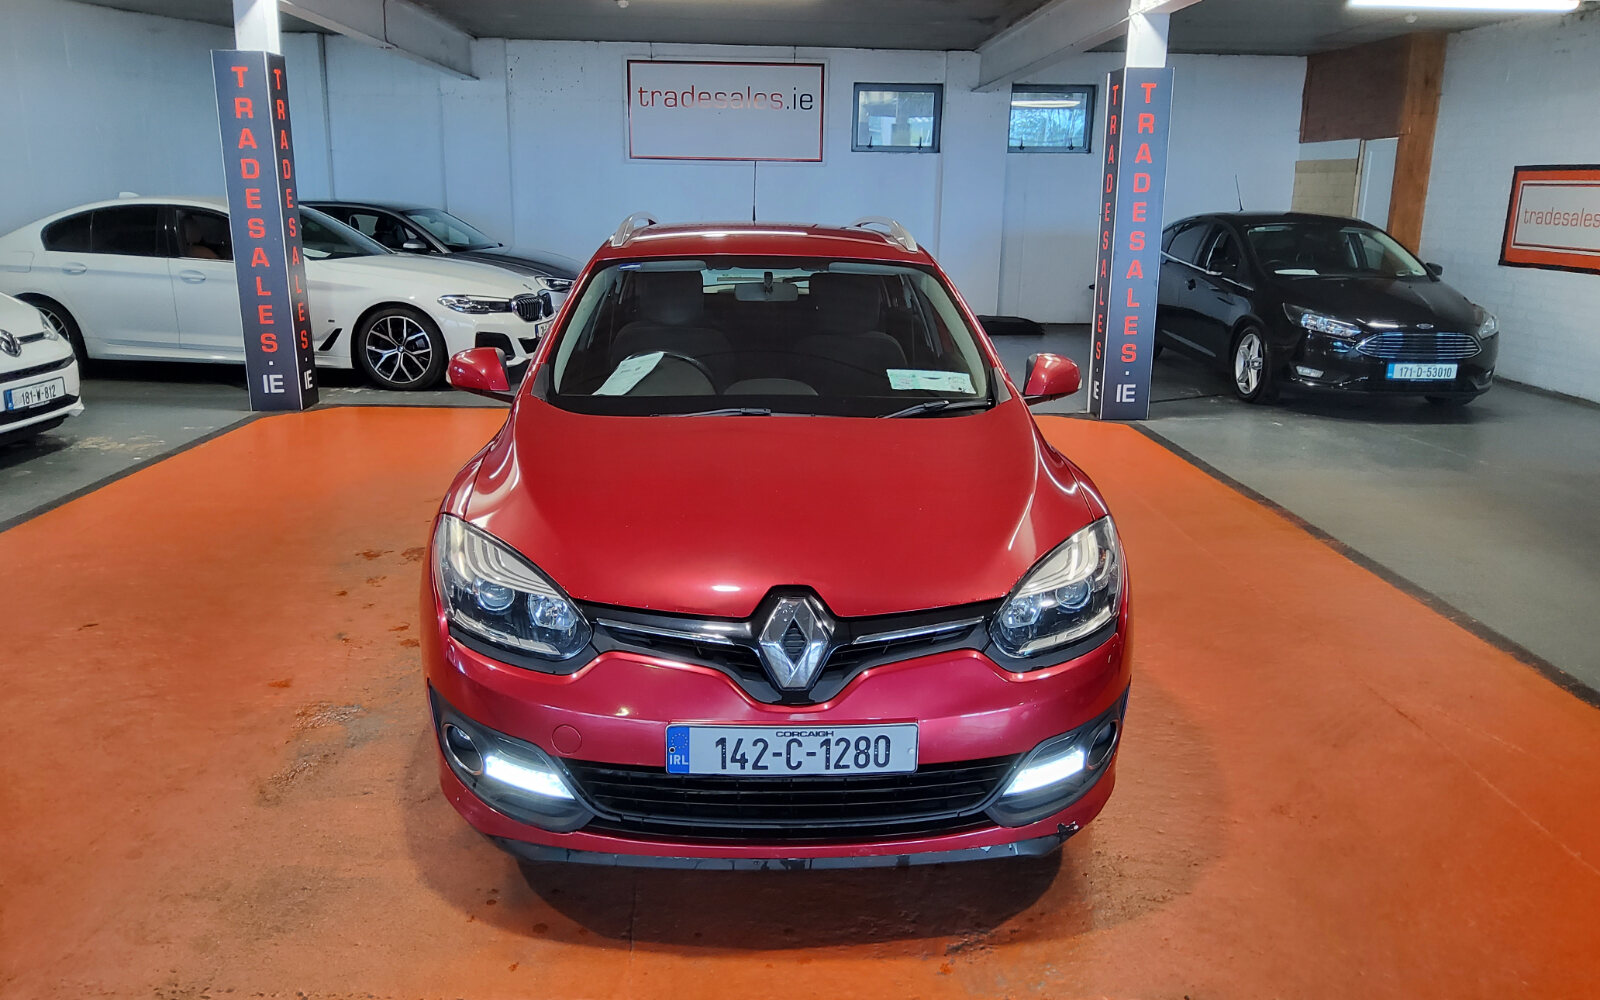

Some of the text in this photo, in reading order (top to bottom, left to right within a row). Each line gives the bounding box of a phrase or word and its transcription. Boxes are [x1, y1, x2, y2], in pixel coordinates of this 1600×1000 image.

[637, 85, 814, 111] tradesales.ie
[1523, 206, 1600, 228] tradesales
[231, 66, 285, 394] TRADESALES.IE
[273, 69, 314, 390] TRADESALES.IE
[1115, 82, 1157, 403] TRADESALES.IE
[1400, 367, 1453, 378] 171-D-53010
[21, 384, 57, 406] 181-W-812
[775, 730, 835, 738] CORCAIGH
[669, 754, 689, 766] IRL
[715, 735, 891, 771] 142-C-1280
